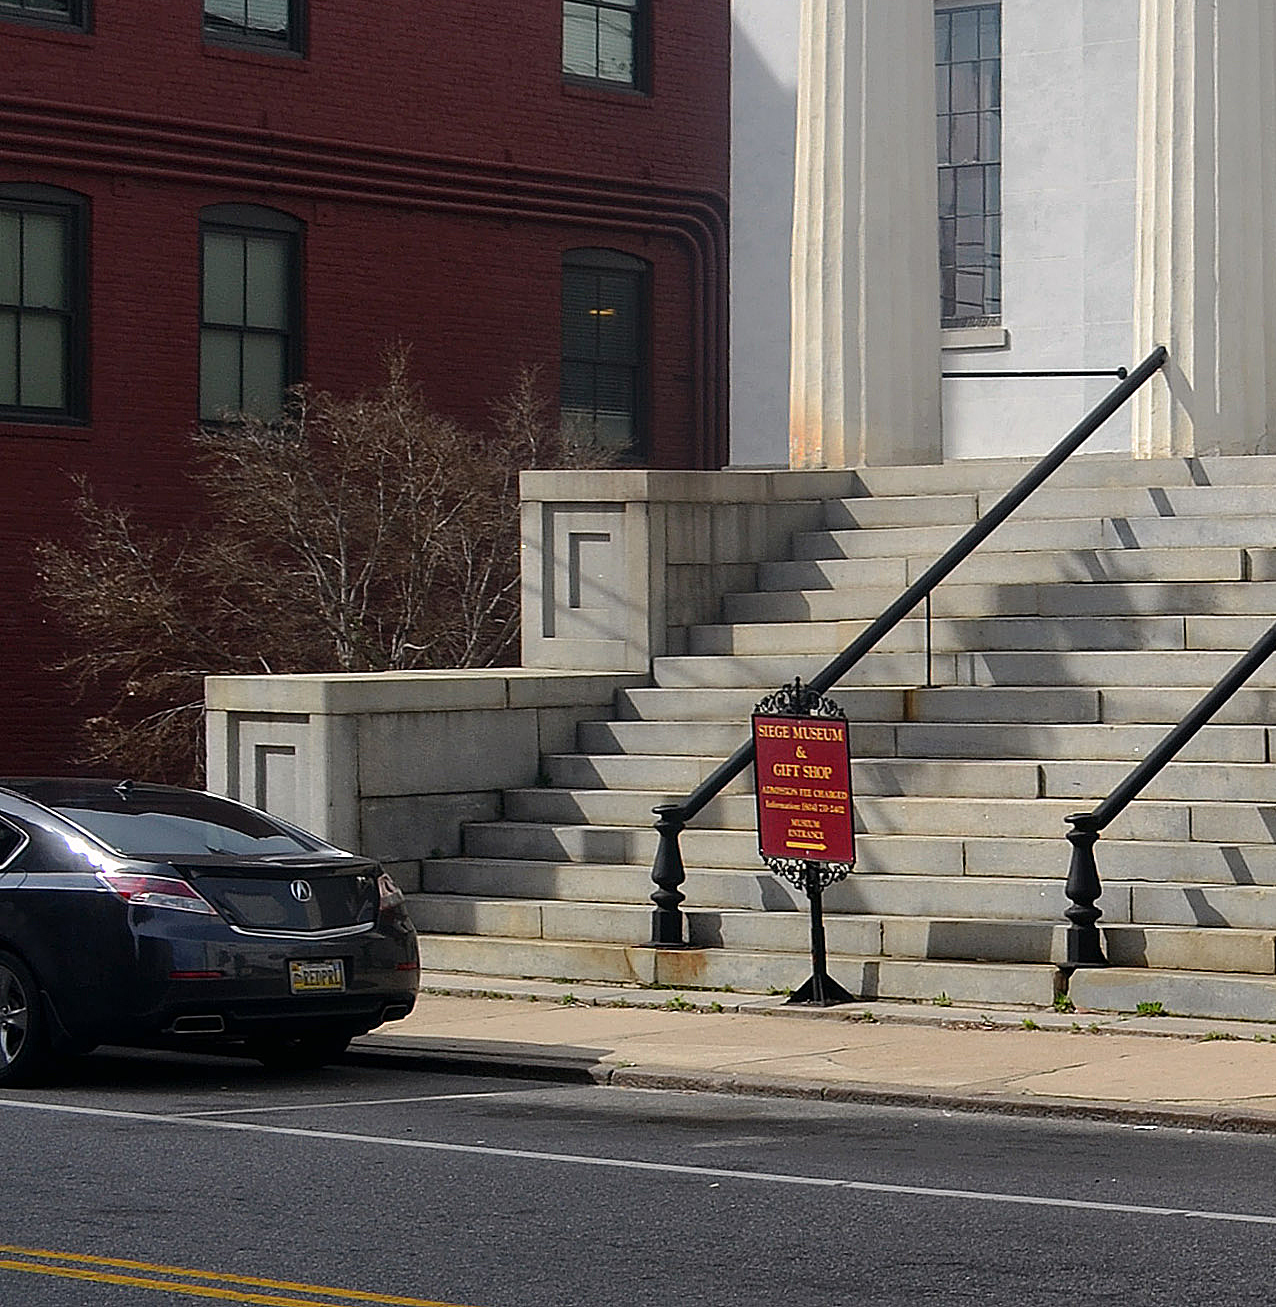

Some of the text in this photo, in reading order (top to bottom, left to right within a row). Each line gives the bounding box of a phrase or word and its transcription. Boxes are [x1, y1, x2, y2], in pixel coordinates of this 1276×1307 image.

[757, 724, 844, 742] SIEGE MUSEUM
[795, 745, 808, 759] &
[773, 763, 833, 780] GIFT SHOP
